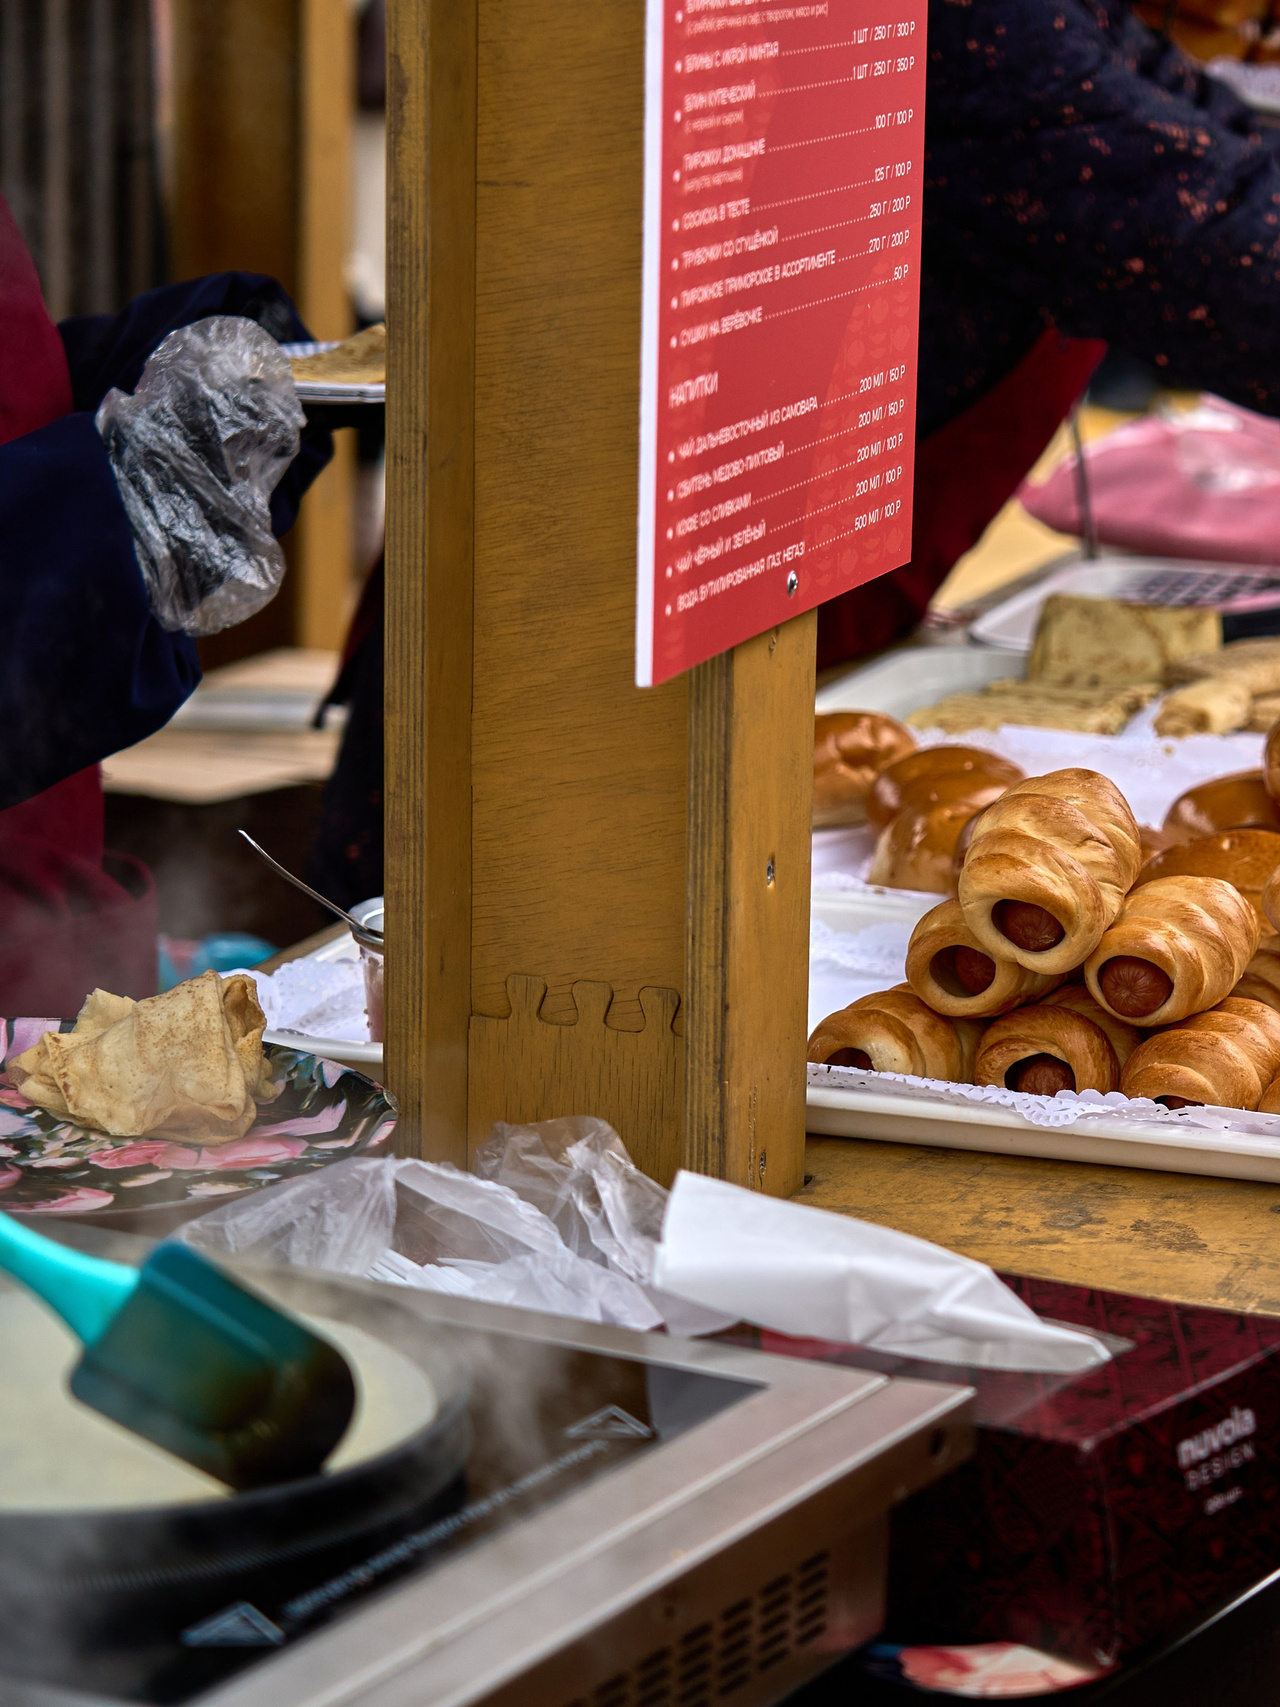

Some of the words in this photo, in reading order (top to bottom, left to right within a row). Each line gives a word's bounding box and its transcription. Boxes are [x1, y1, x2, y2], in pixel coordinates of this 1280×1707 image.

[685, 53, 714, 73] БЛИНЫ
[715, 50, 721, 67] С
[722, 42, 748, 66] ИКРОЙ
[749, 41, 778, 61] МИНТАЯ
[857, 28, 868, 44] ШТ
[874, 25, 887, 41] 250
[887, 24, 892, 39] Г
[897, 22, 909, 37] 300
[910, 21, 915, 35] Р
[685, 93, 707, 112] БЛИН
[708, 79, 756, 107] КУПЕЧЕСКИЙ
[857, 64, 868, 79] ШТ
[873, 61, 886, 76] 250
[887, 60, 892, 74] Г
[897, 57, 908, 72] 350
[909, 56, 914, 70] Р
[683, 148, 721, 171] ПИРОЖКИ
[722, 137, 765, 164] ДОМАШНИЕ
[875, 114, 886, 129] 100
[887, 113, 892, 127] Г
[897, 110, 907, 125] 100
[908, 108, 913, 122] Р
[682, 206, 718, 230] СОСИСКА
[719, 204, 725, 221] В
[727, 197, 750, 218] ТЕСТЕ
[875, 166, 884, 182] 125
[886, 165, 890, 179] Г
[896, 162, 905, 177] 100
[906, 161, 911, 175] Р
[682, 243, 721, 269] ТРУБОЧКИ
[723, 240, 734, 257] СО
[869, 203, 881, 218] 250
[882, 201, 887, 215] Г
[892, 198, 904, 213] 200
[905, 195, 910, 209] Р
[680, 323, 708, 347] СУШКИ
[709, 320, 720, 338] НА
[894, 266, 902, 280] 50
[903, 264, 908, 278] Р
[681, 280, 723, 308] ПИРОЖНОЕ
[724, 266, 774, 294] ПРИМОРСКОЕ
[774, 264, 780, 281] В
[781, 250, 836, 278] АССОРТИМЕНТЕ
[869, 238, 880, 253] 270
[881, 236, 886, 250] Г
[891, 232, 903, 247] 200
[904, 230, 909, 243] Р
[668, 370, 718, 409] НАПИТКИ
[678, 436, 694, 460] ЧАЙ
[695, 410, 769, 455] ДАЛЬНЕВОСТОЧНЫЙ
[770, 409, 780, 426] ИЗ
[781, 396, 818, 421] САМОВАРА
[860, 376, 872, 393] 200
[873, 372, 883, 388] МЛ
[889, 367, 899, 383] 150
[900, 364, 905, 378] Р
[676, 472, 712, 499] СБИТЕНЬ
[713, 440, 784, 484] МЕДОВО-ПИХТОВЫЙ
[859, 411, 870, 428] 200
[872, 407, 882, 423] МЛ
[888, 401, 898, 417] 150
[899, 399, 904, 412] Р
[676, 513, 699, 537] КОФЕ
[700, 509, 711, 527] СО
[712, 492, 752, 521] СЛИВКАМИ
[857, 445, 869, 463] 200
[870, 441, 880, 457] МЛ
[887, 435, 897, 451] 100
[898, 433, 903, 446] Р
[675, 549, 693, 575] ЧАЙ
[725, 537, 731, 554] И
[856, 480, 868, 497] 200
[869, 474, 880, 490] МЛ
[886, 469, 896, 484] 100
[897, 466, 902, 480] Р
[677, 588, 699, 613] ВОДА
[700, 558, 765, 602] БУТИЛИРОВАННАЯ
[855, 514, 867, 531] 500
[868, 509, 878, 525] МЛ
[885, 502, 895, 518] 100
[896, 500, 901, 514] Р
[1178, 1406, 1256, 1469] nuvola
[1185, 1441, 1255, 1491] DESIGN
